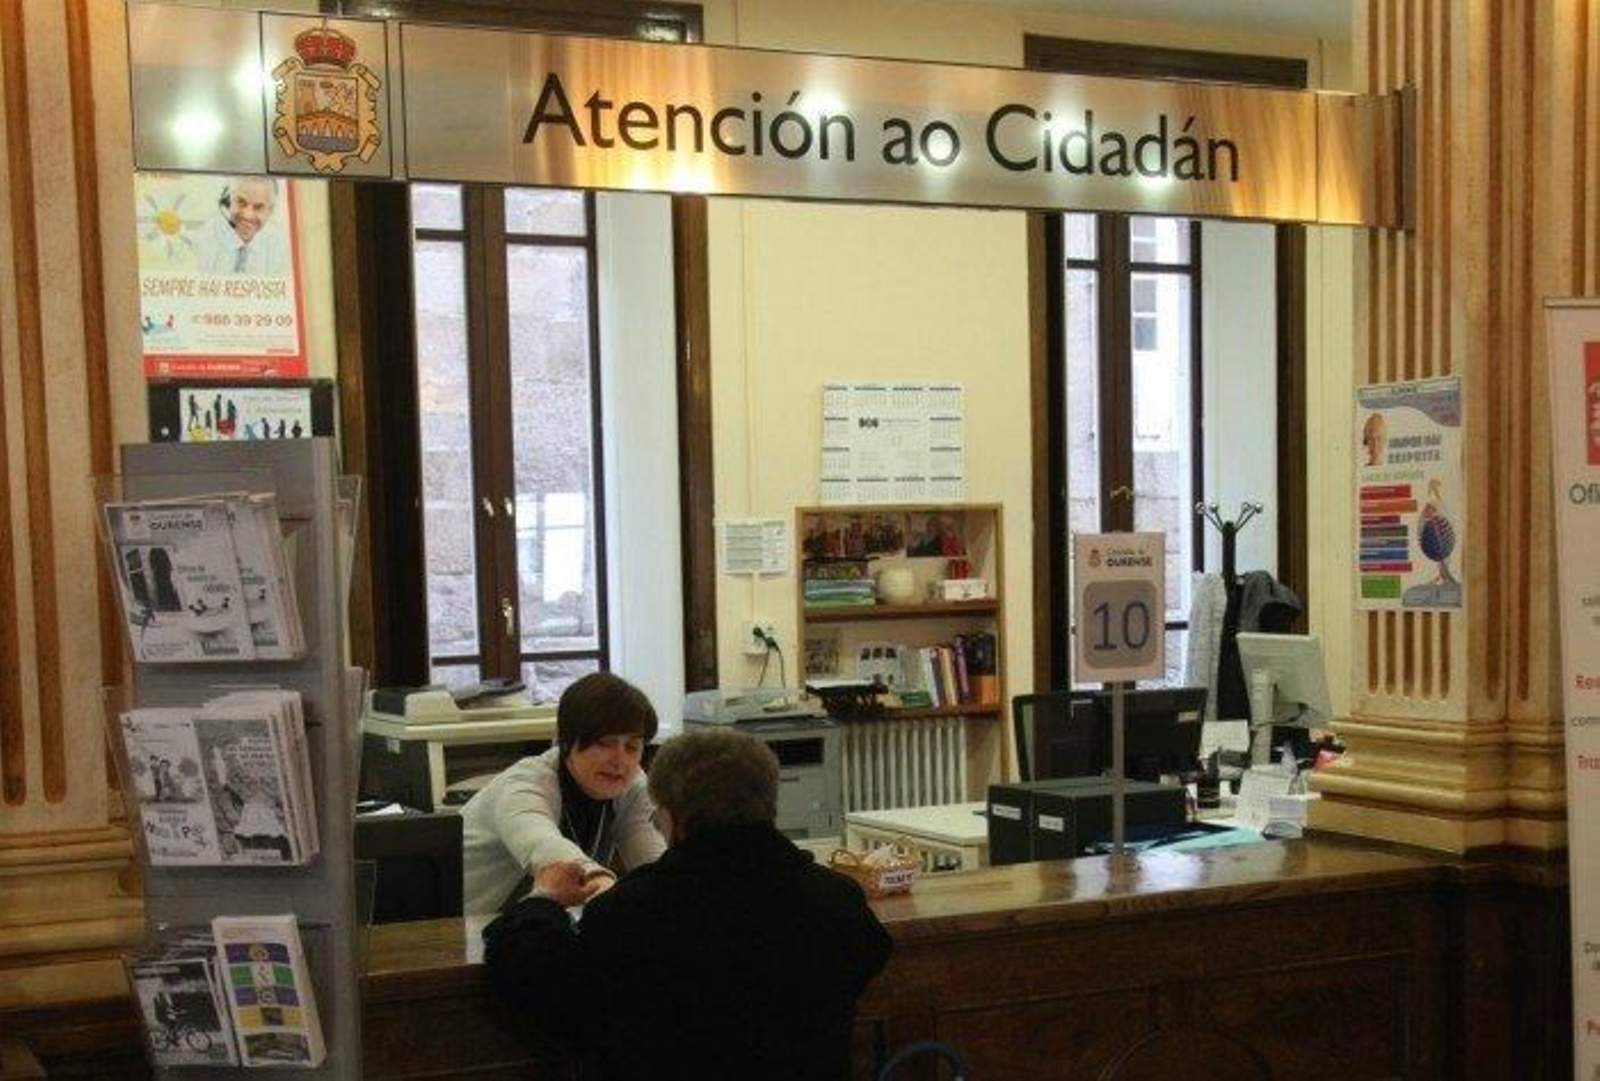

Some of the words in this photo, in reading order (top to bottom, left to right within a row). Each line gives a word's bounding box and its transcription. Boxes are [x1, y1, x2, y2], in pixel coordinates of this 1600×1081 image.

[522, 73, 855, 162] Atención
[882, 115, 962, 167] ao
[986, 103, 1239, 182] Cidadán
[142, 278, 196, 297] SEMPRE
[224, 279, 287, 299] RESPOSTA
[255, 314, 273, 327] 29
[1107, 556, 1153, 567] OURENSE
[1093, 600, 1150, 650] 10
